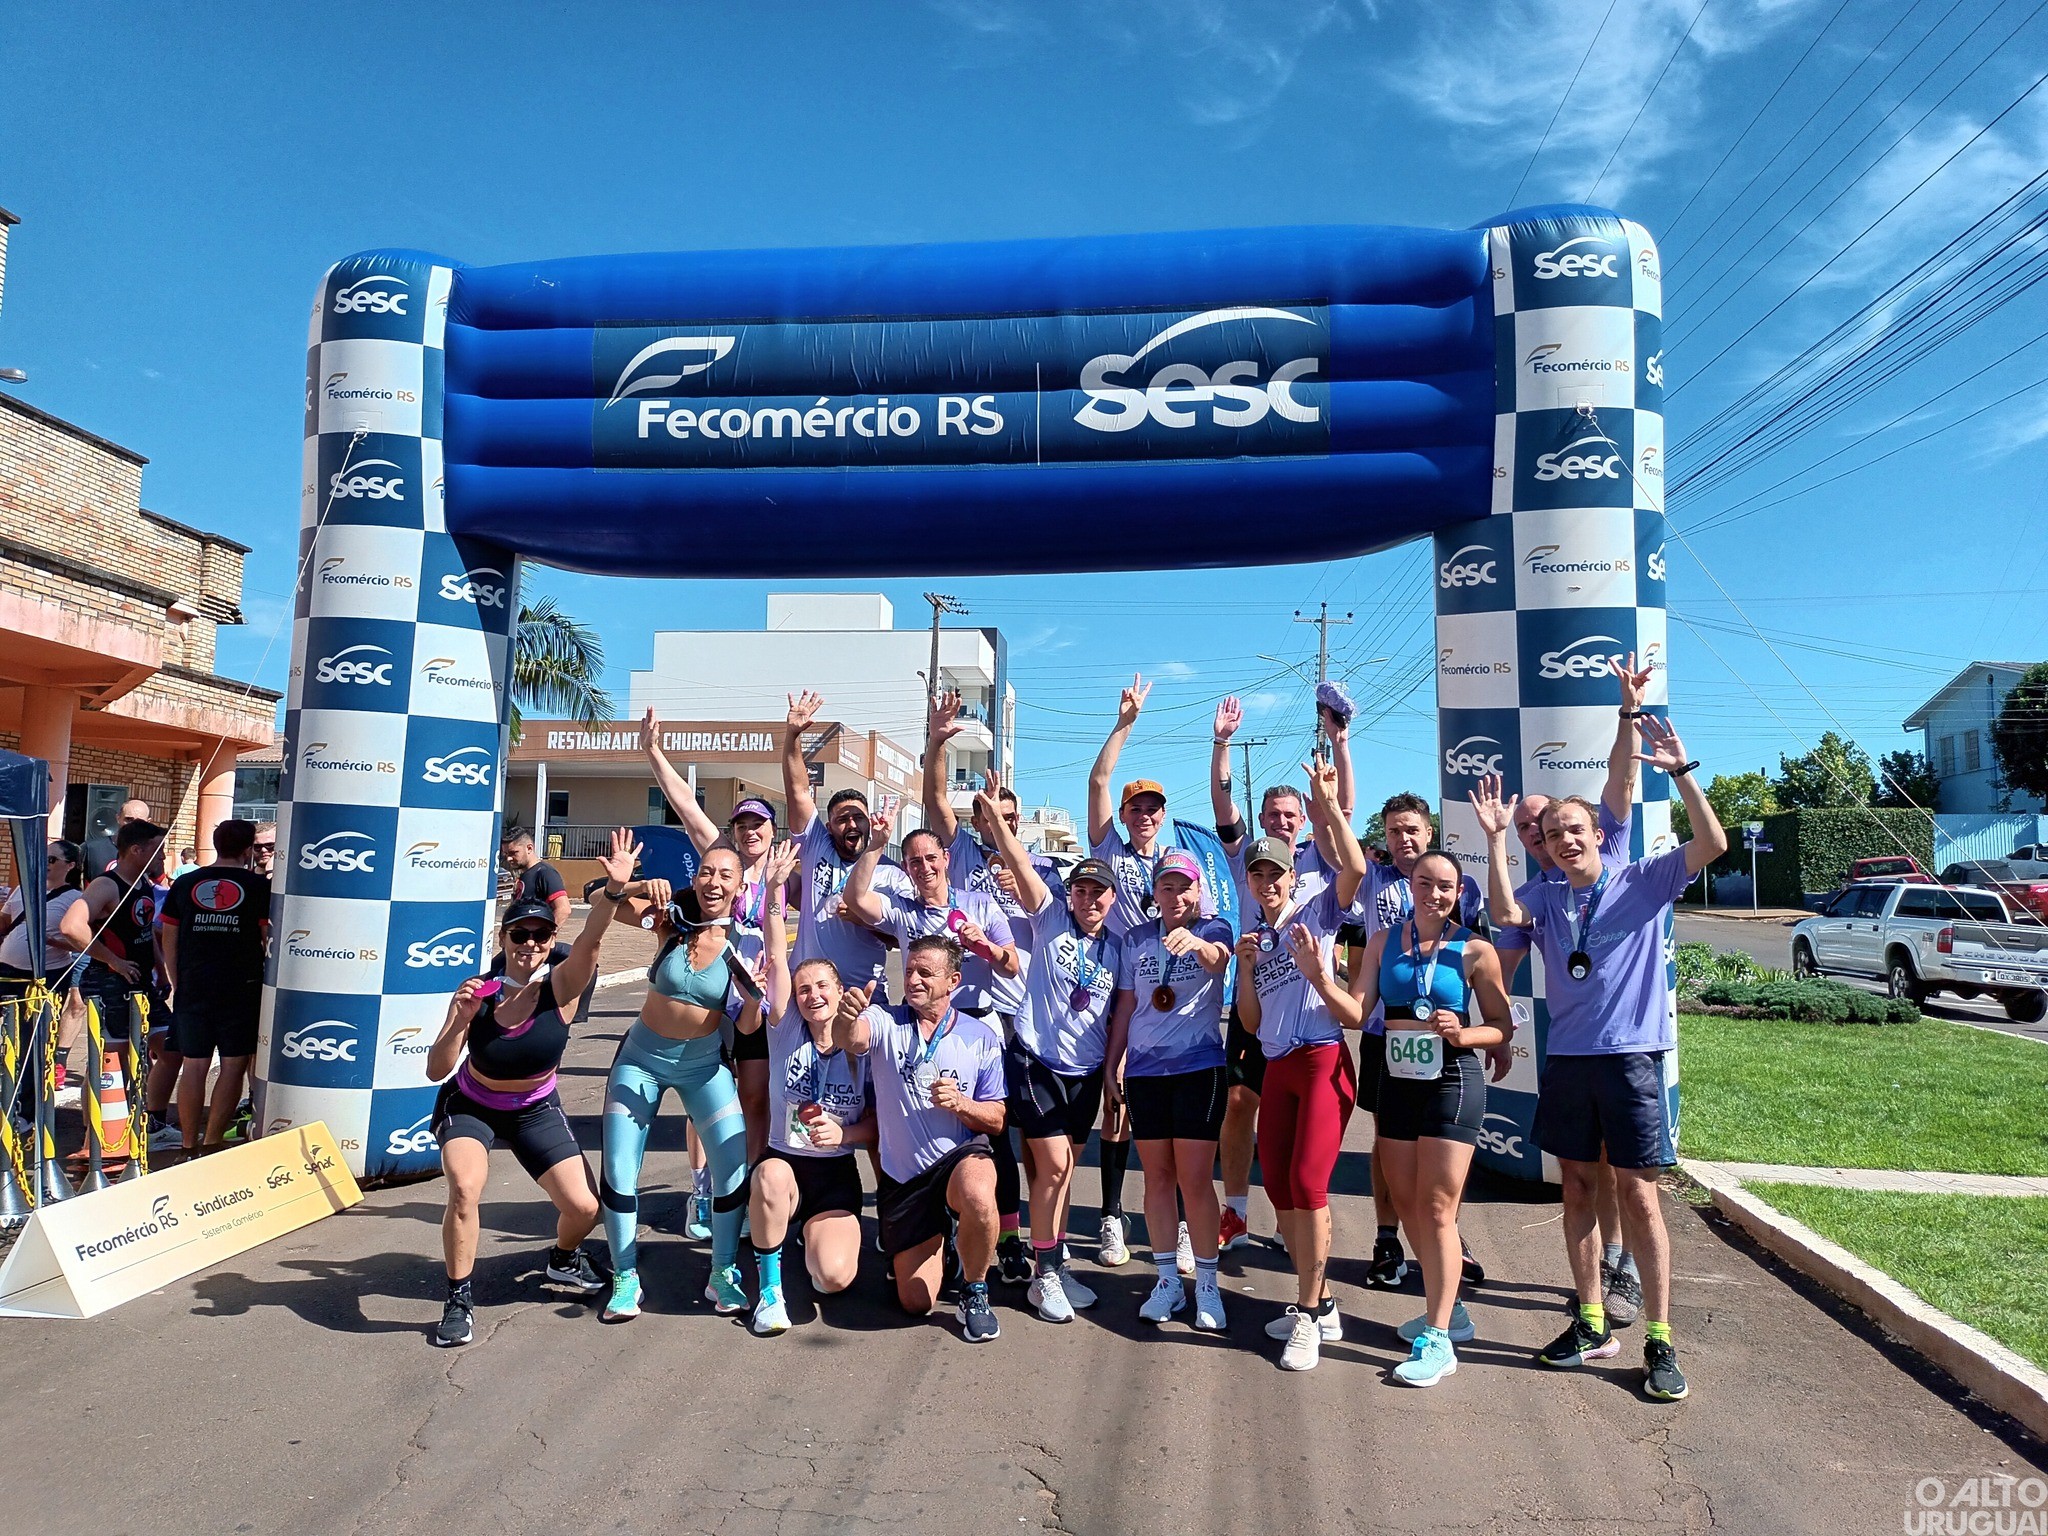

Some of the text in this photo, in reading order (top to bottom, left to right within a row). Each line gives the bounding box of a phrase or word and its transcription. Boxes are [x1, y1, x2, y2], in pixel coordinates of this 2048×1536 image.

[1533, 358, 1630, 374] Fecomércio RS
[328, 386, 415, 403] Fecomércio RS
[638, 394, 1005, 439] Fecomércio RS
[1532, 559, 1630, 574] Fecomércio RS
[322, 572, 413, 588] Fecomércio RS
[1441, 661, 1511, 675] Fecomércio RS
[428, 673, 503, 692] Fecomércio RS
[547, 730, 774, 752] RESTAURANT CHURRASCARIA
[305, 758, 396, 774] Fecomércio RS
[1539, 757, 1609, 770] Fecomérci
[411, 854, 488, 869] Fecomércio RS
[1206, 852, 1219, 911] ecomércio
[194, 913, 240, 925] RUNNING
[288, 944, 378, 961] Fecomércio RS
[1964, 951, 2048, 964] CHEVROLE
[1391, 1037, 1435, 1064] 648
[1512, 1046, 1529, 1058] RS
[824, 1094, 862, 1105] EDRAS
[340, 1138, 360, 1150] RS
[75, 1221, 159, 1262] Fecomércio
[158, 1211, 179, 1230] RS
[193, 1186, 254, 1217] Sindicatos
[201, 1209, 264, 1240] Sistema Comércio
